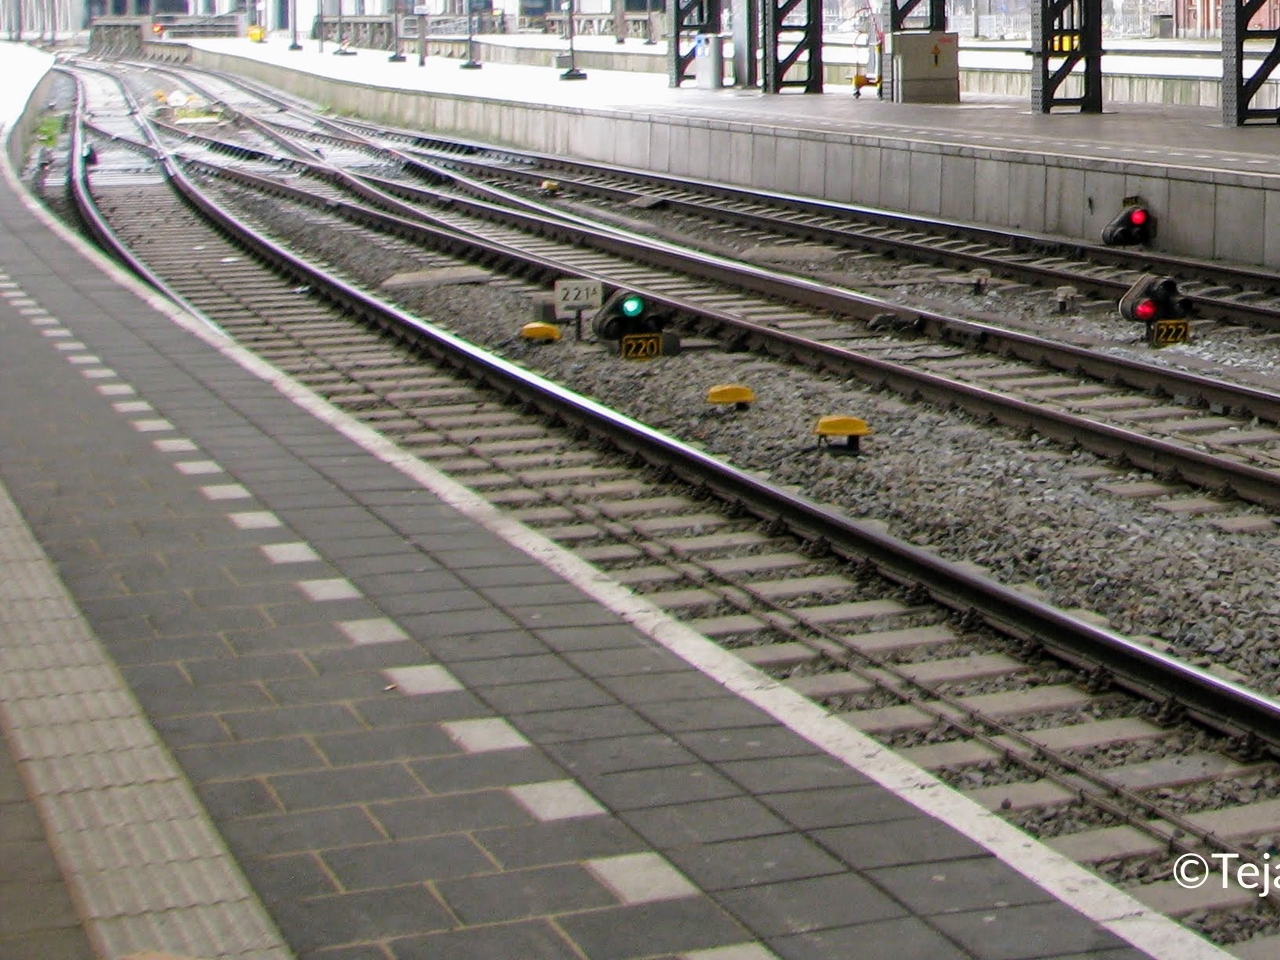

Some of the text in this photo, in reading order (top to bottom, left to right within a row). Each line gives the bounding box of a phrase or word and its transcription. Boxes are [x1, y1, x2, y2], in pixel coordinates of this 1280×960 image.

[561, 287, 597, 301] 221A
[1159, 325, 1186, 341] 222
[627, 339, 658, 357] 220
